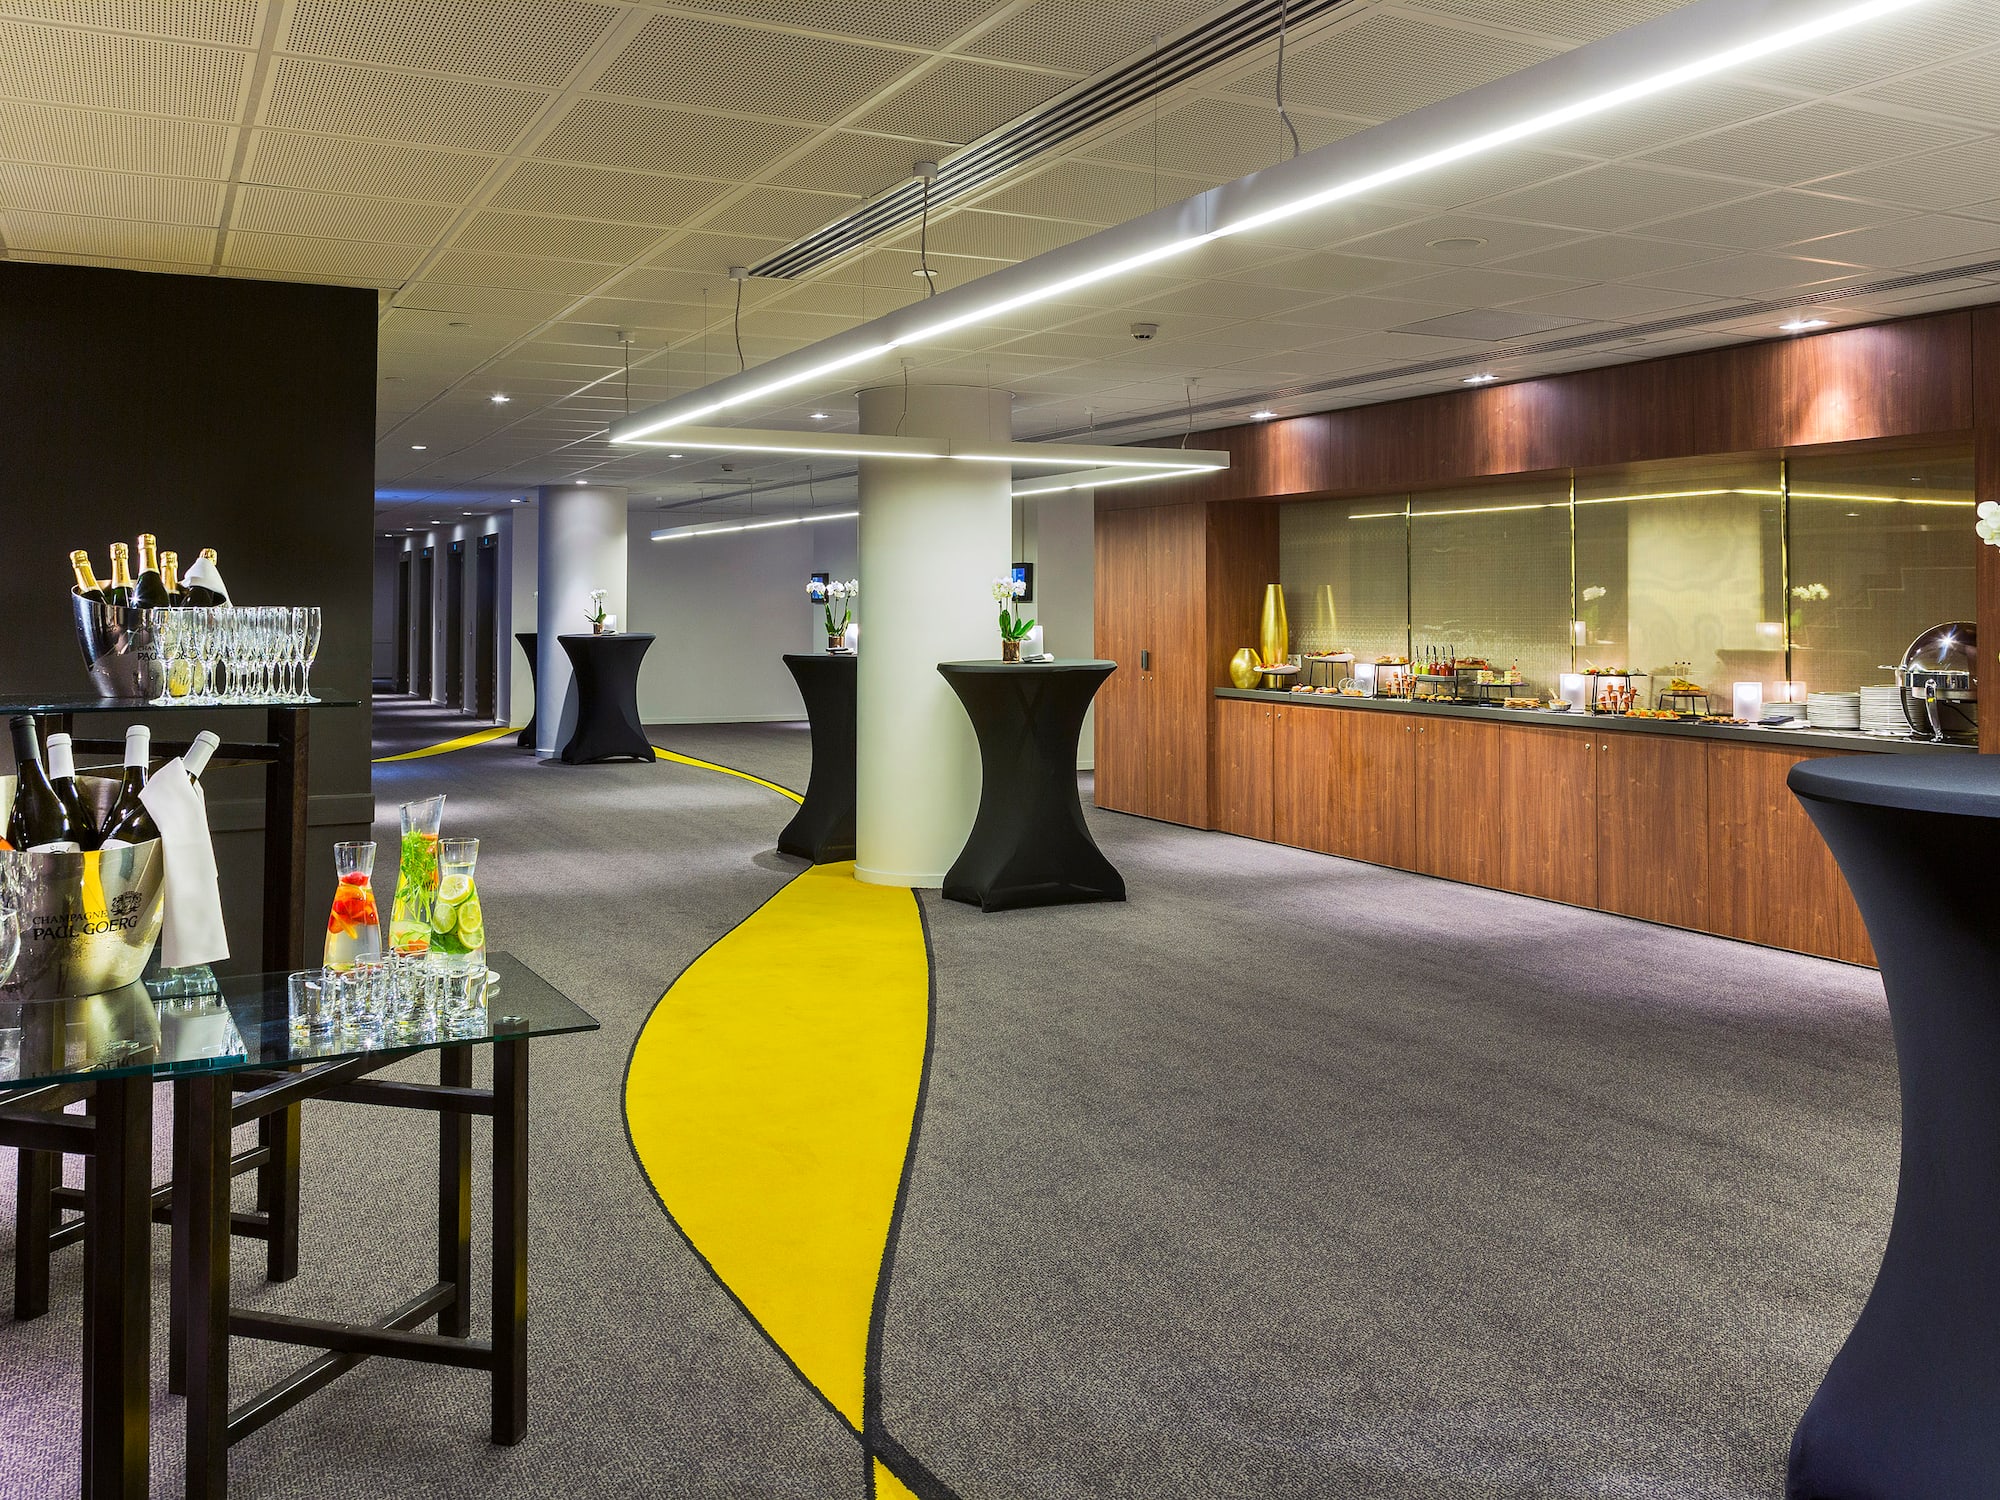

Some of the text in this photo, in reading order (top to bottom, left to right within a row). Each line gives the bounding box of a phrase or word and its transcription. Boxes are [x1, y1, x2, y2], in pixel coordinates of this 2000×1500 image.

[137, 652, 159, 661] PAU
[33, 910, 108, 925] CHAMPAGNE
[33, 916, 138, 941] PAUL GOERG
